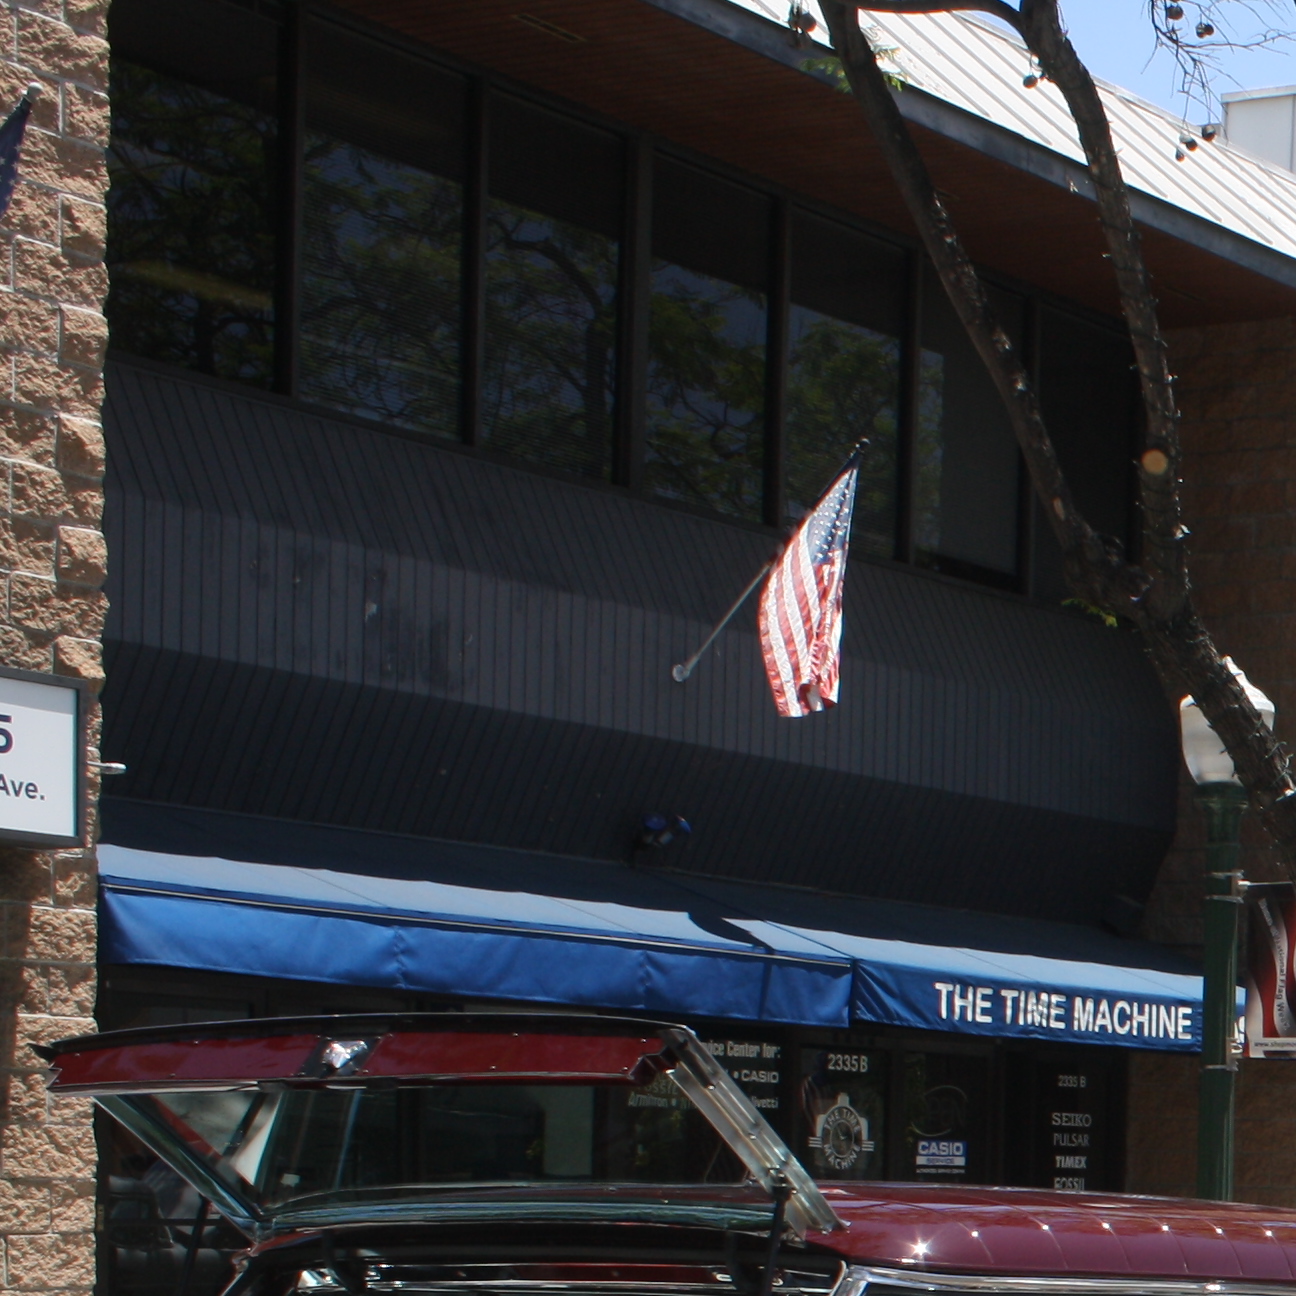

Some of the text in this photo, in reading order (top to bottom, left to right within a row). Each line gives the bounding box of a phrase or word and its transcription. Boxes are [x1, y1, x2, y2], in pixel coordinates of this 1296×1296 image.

[934, 982, 993, 1024] THE
[1000, 989, 1066, 1030] TIME
[1072, 996, 1193, 1040] MACHINE
[726, 1041, 761, 1057] Center
[740, 1070, 779, 1083] CASIO
[1052, 1112, 1092, 1127] SEIKO
[1053, 1133, 1090, 1147] PULSAR
[918, 1141, 963, 1155] CASIO
[1055, 1155, 1087, 1169] TIMEX
